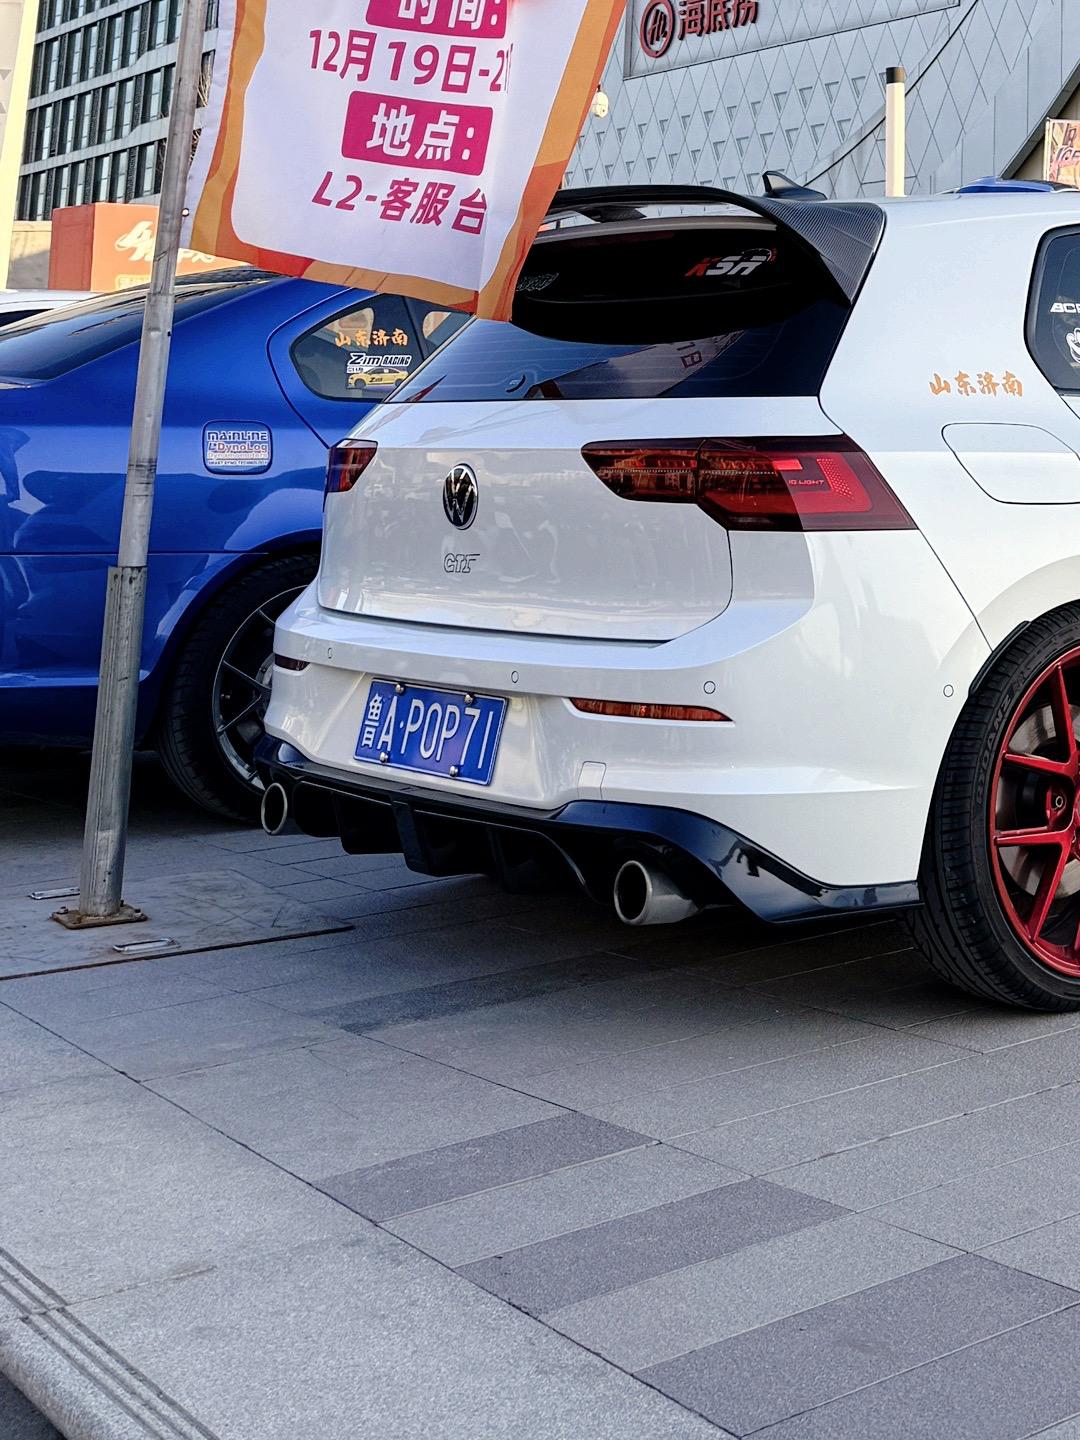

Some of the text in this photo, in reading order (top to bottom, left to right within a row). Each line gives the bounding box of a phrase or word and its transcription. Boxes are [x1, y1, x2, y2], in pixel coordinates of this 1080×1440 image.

[312, 171, 488, 235] L2-客服台
[335, 328, 408, 348] 山东济南
[929, 370, 1023, 397] 山东济南
